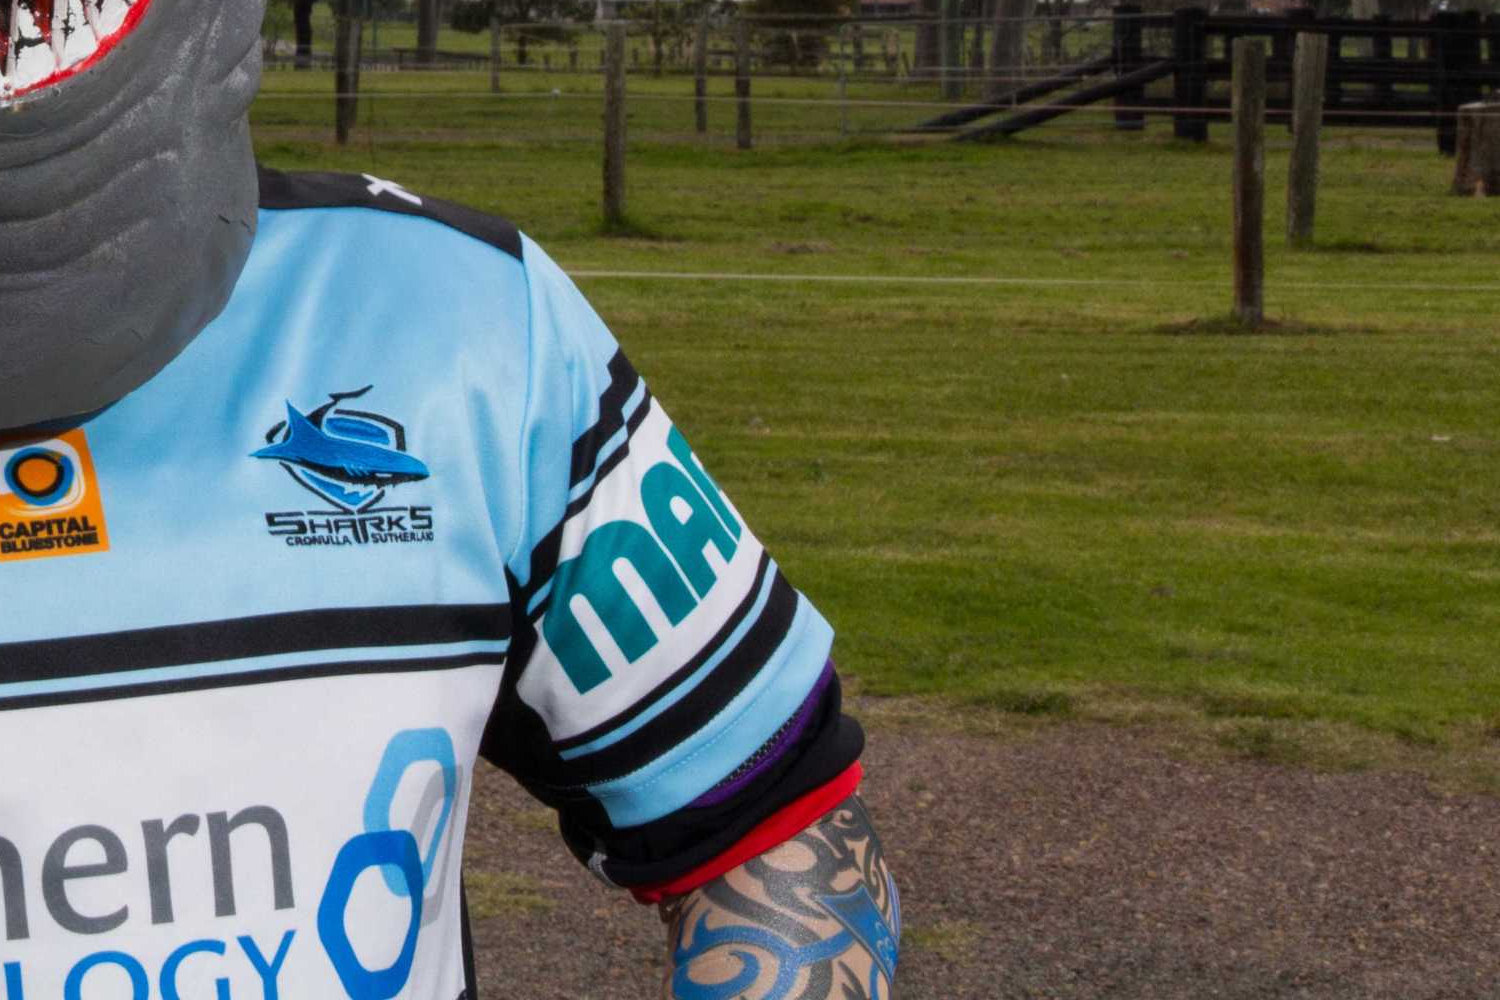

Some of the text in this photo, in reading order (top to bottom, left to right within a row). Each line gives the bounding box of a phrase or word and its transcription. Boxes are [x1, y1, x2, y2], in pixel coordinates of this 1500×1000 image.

[265, 506, 433, 544] SHARKS
[0, 531, 100, 554] BLUESTONE
[286, 534, 352, 546] CRONULLA
